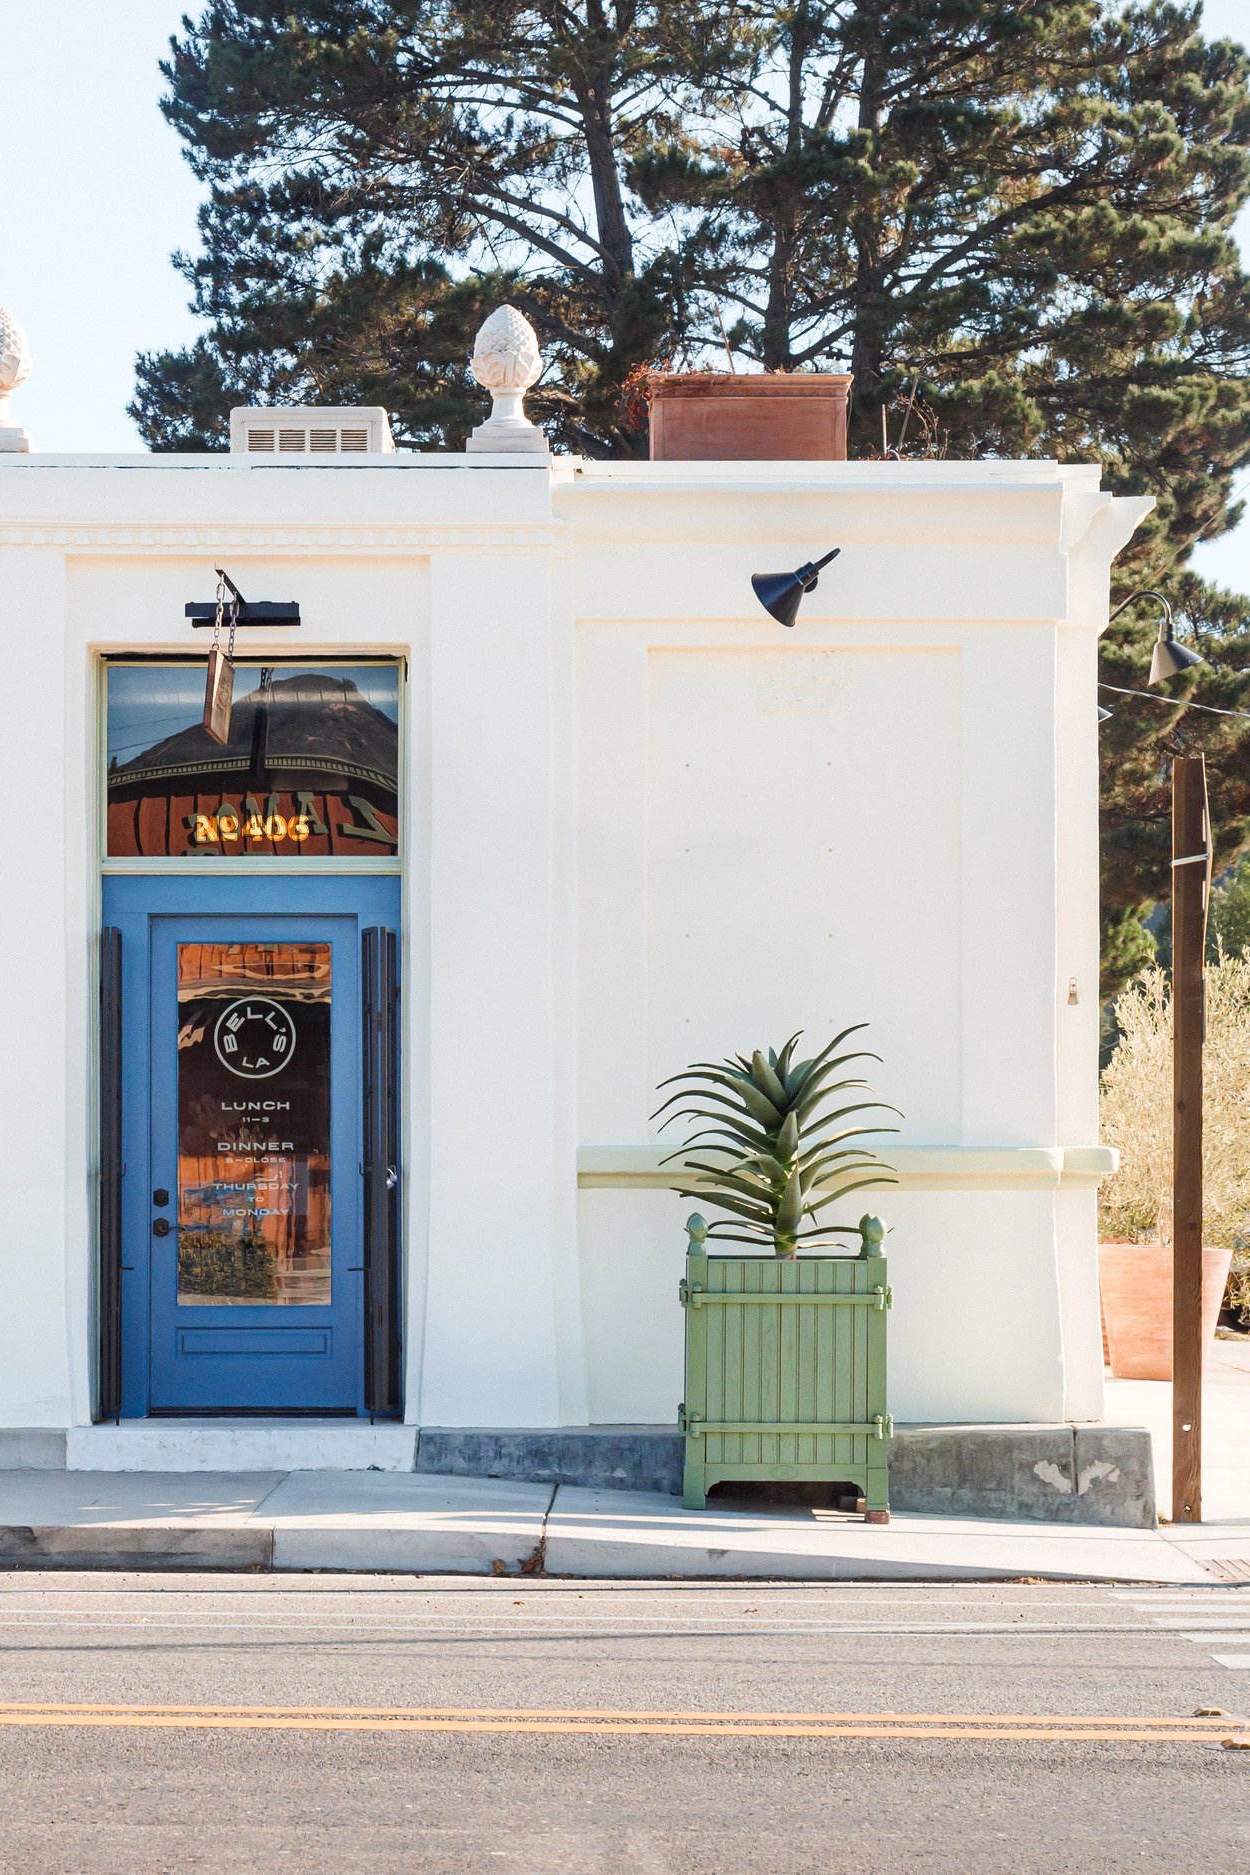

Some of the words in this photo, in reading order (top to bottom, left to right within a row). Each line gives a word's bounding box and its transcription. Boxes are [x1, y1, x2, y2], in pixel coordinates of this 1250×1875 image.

[241, 814, 310, 842] 406
[223, 1006, 287, 1053] BELL'S
[241, 1056, 271, 1069] LA
[221, 1101, 290, 1111] LUNCH
[217, 1142, 295, 1151] DINNER
[222, 1208, 290, 1216] MONDAY
